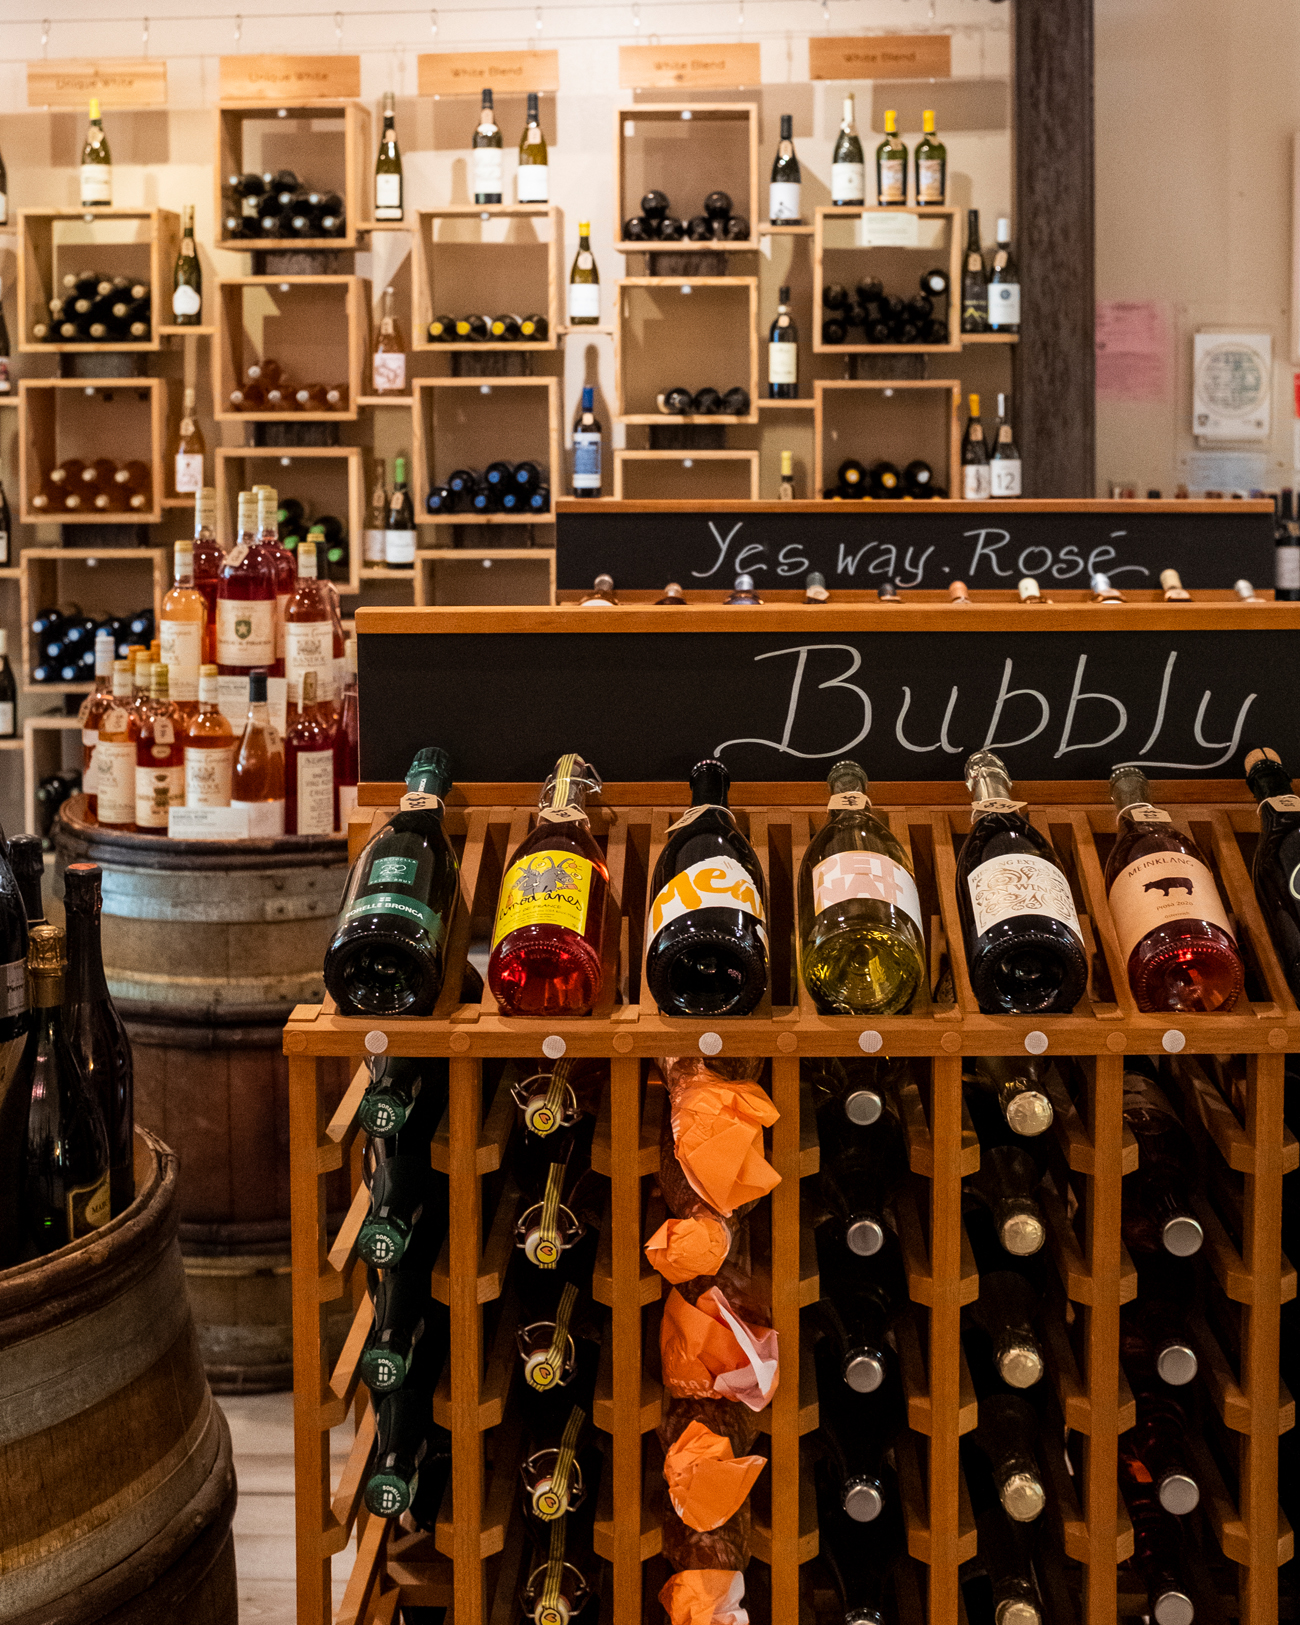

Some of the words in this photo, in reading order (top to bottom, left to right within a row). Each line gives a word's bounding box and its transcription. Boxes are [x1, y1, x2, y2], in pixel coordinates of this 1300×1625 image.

[692, 520, 809, 577] Yes
[963, 527, 1149, 579] Rosé
[714, 643, 1258, 771] Bubbly
[1128, 857, 1194, 878] MEINKLANG
[345, 902, 383, 919] SORELLE
[384, 902, 424, 920] BRONCA
[377, 1102, 396, 1120] SORELLE
